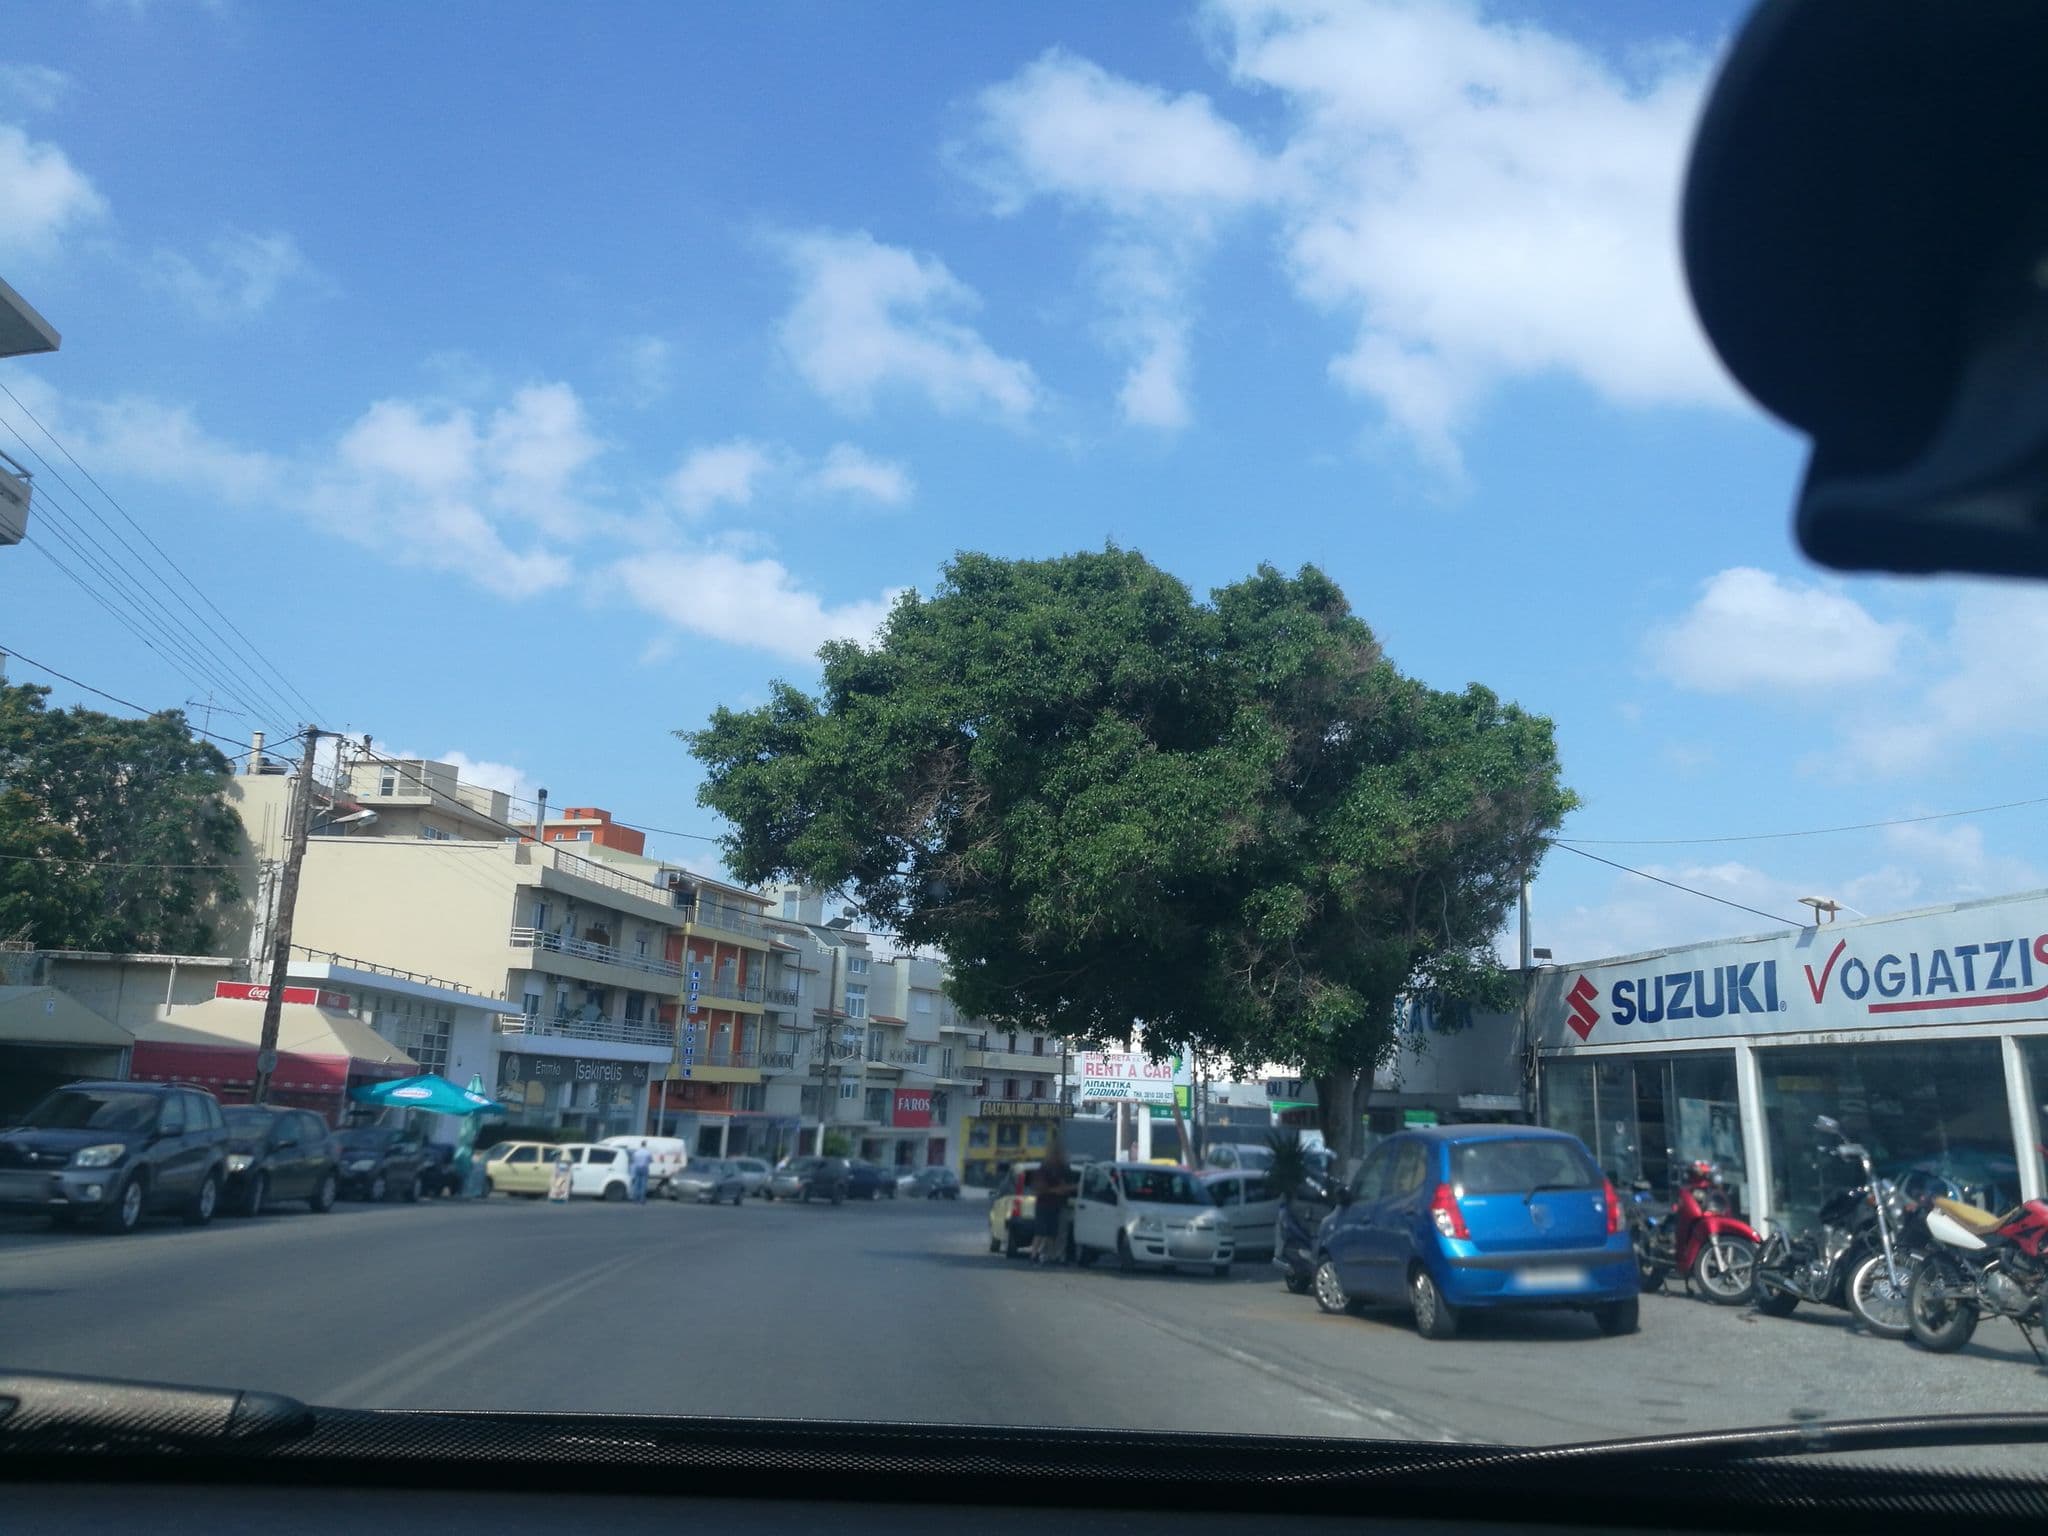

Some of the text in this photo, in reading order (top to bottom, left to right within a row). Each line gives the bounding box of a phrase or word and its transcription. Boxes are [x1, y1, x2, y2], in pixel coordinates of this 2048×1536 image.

[1611, 959, 1779, 1027] SUZUKI
[684, 970, 700, 1078] LIFE HOTEL
[574, 1059, 623, 1081] Tsakirelis
[1085, 1062, 1171, 1079] RENT A CAR
[1084, 1080, 1131, 1089] ΛΙΠΑΝΤΙΚΑ
[898, 1097, 930, 1112] FAROS
